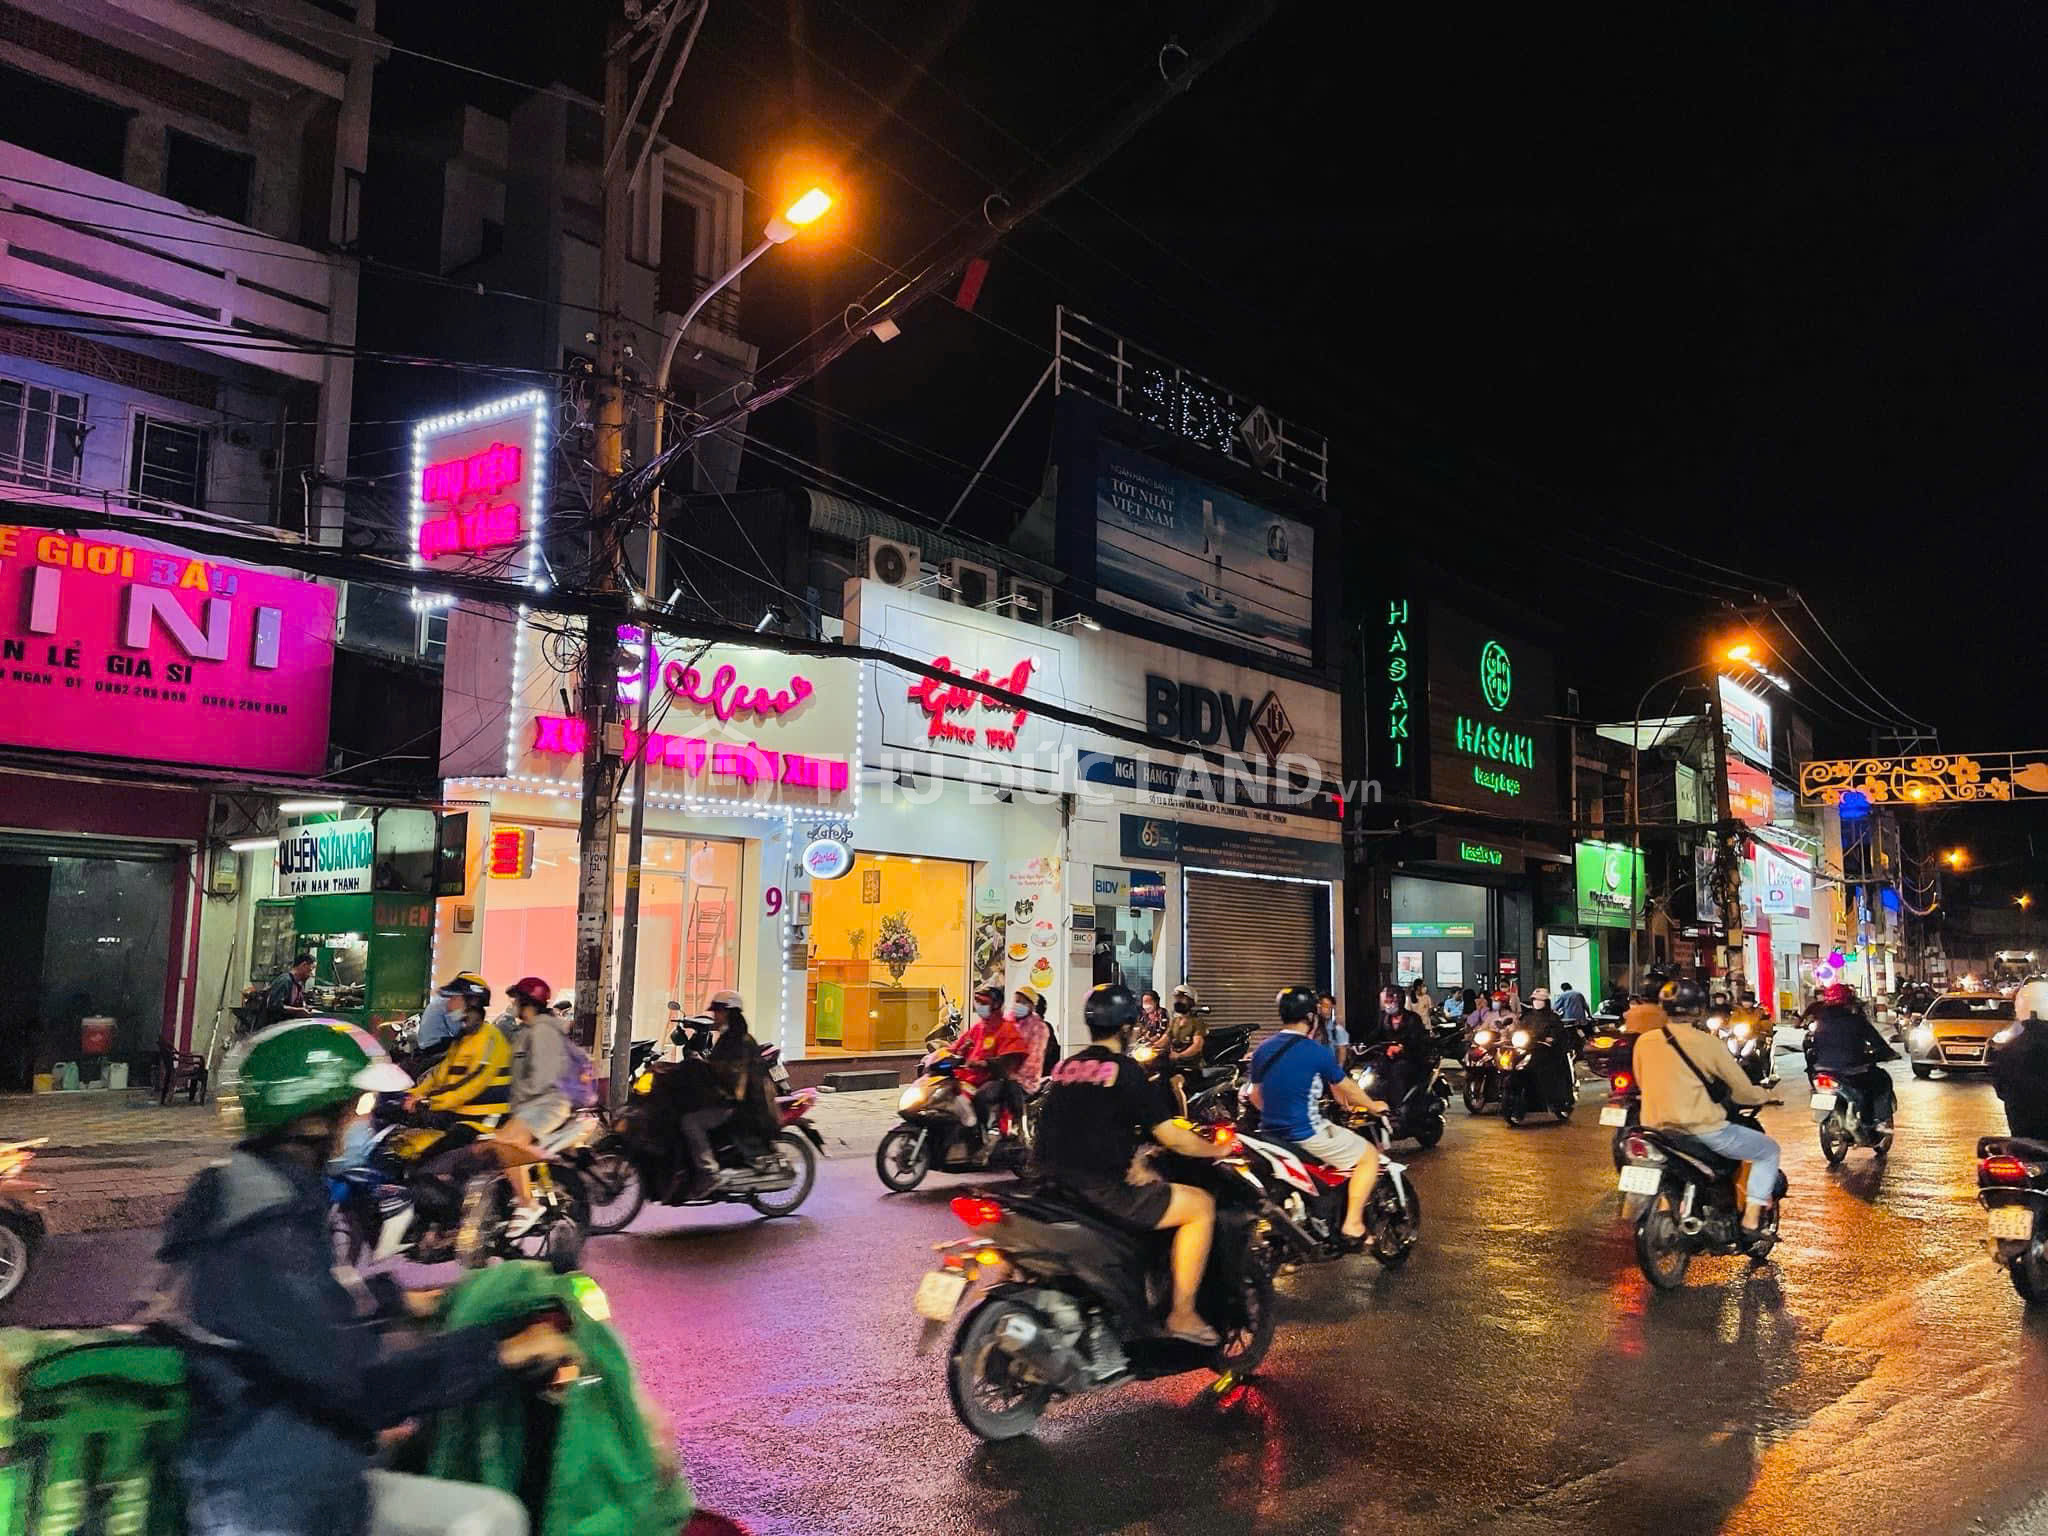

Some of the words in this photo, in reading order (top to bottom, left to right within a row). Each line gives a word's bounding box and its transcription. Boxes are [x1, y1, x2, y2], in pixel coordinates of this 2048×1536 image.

[1388, 600, 1408, 768] HASAKI
[1146, 674, 1254, 752] BIDV
[1457, 716, 1533, 769] HASAKI
[766, 887, 783, 917] 9
[1096, 879, 1118, 895] BIDV
